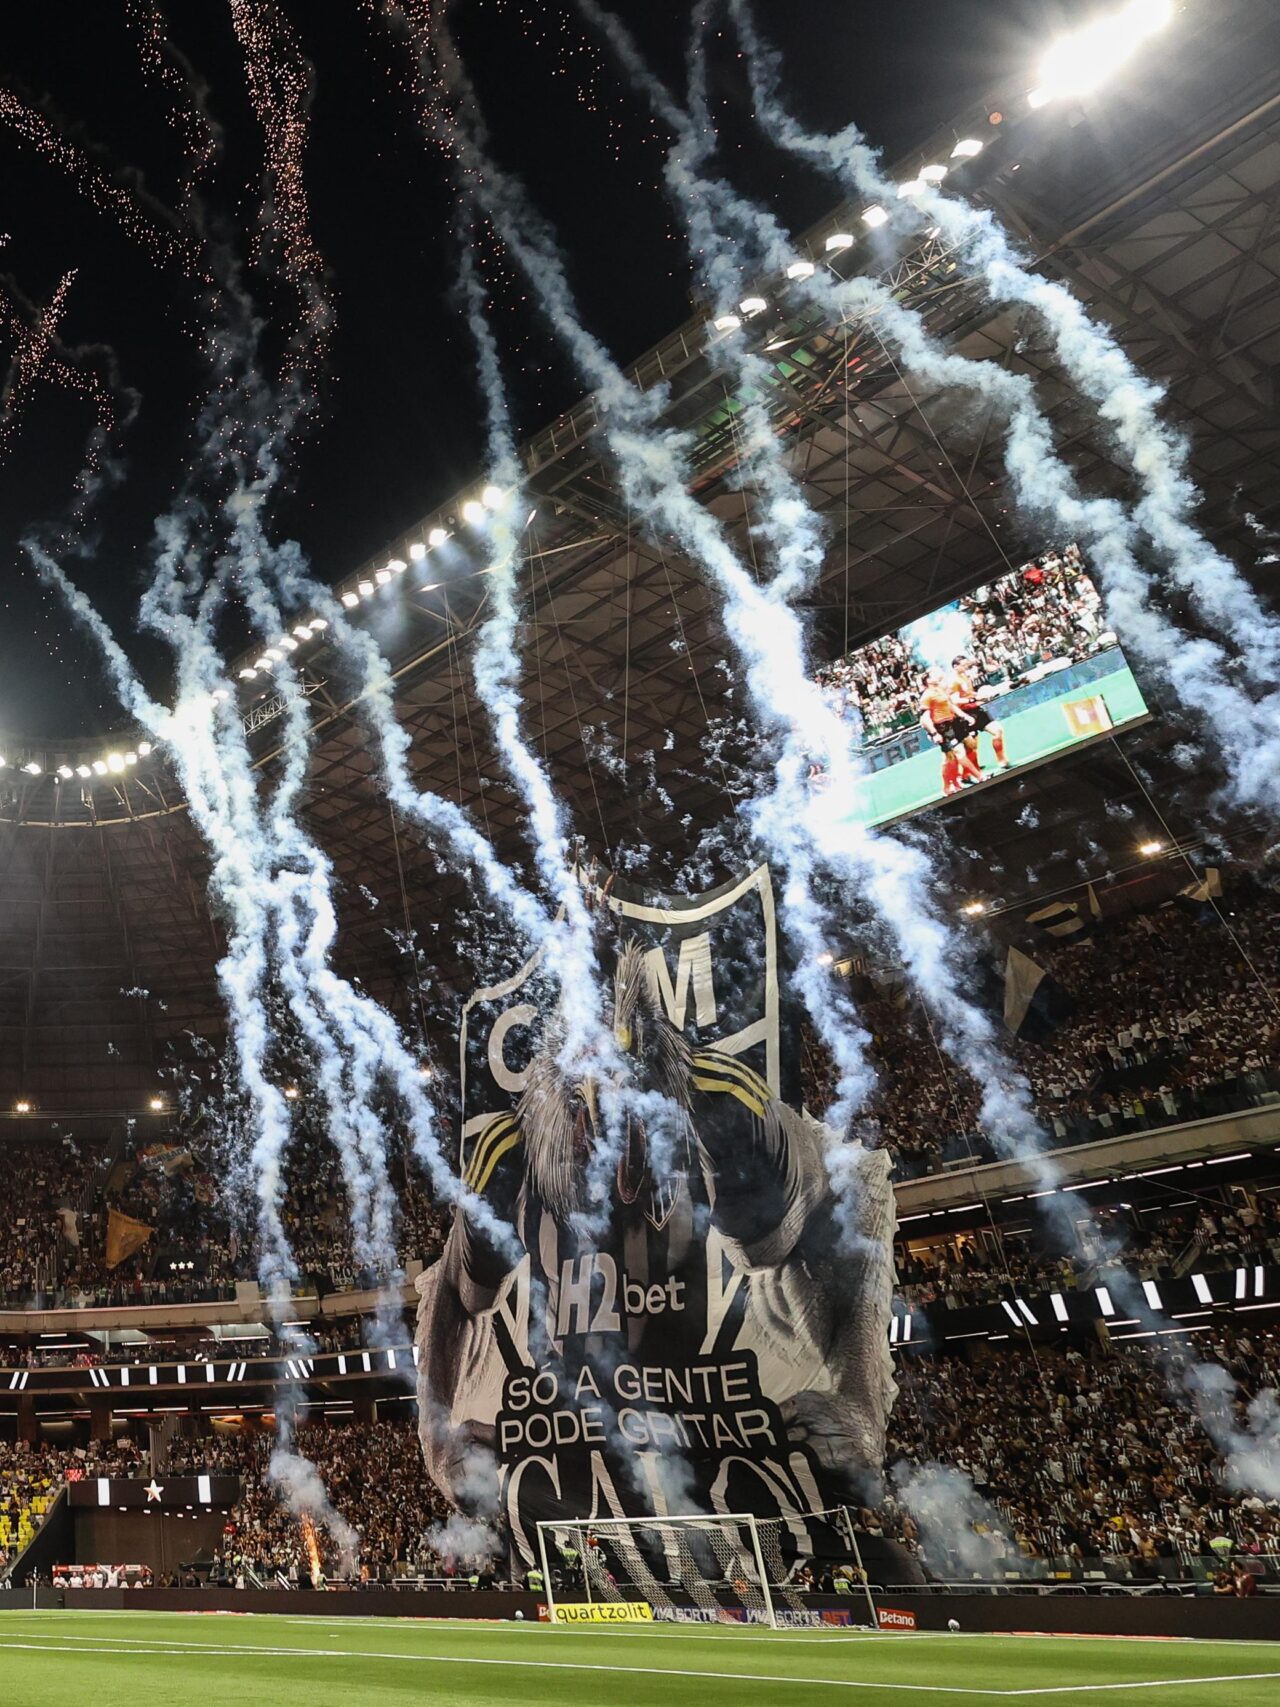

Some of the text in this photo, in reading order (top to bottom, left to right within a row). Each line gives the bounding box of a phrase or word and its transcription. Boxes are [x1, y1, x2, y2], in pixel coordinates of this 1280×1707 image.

[508, 1362, 751, 1411] SÓ A GENTE
[501, 1408, 776, 1452] PODE GRITAR
[556, 1603, 648, 1622] quartzolit
[822, 1610, 850, 1625] BET
[880, 1611, 915, 1627] Betano
